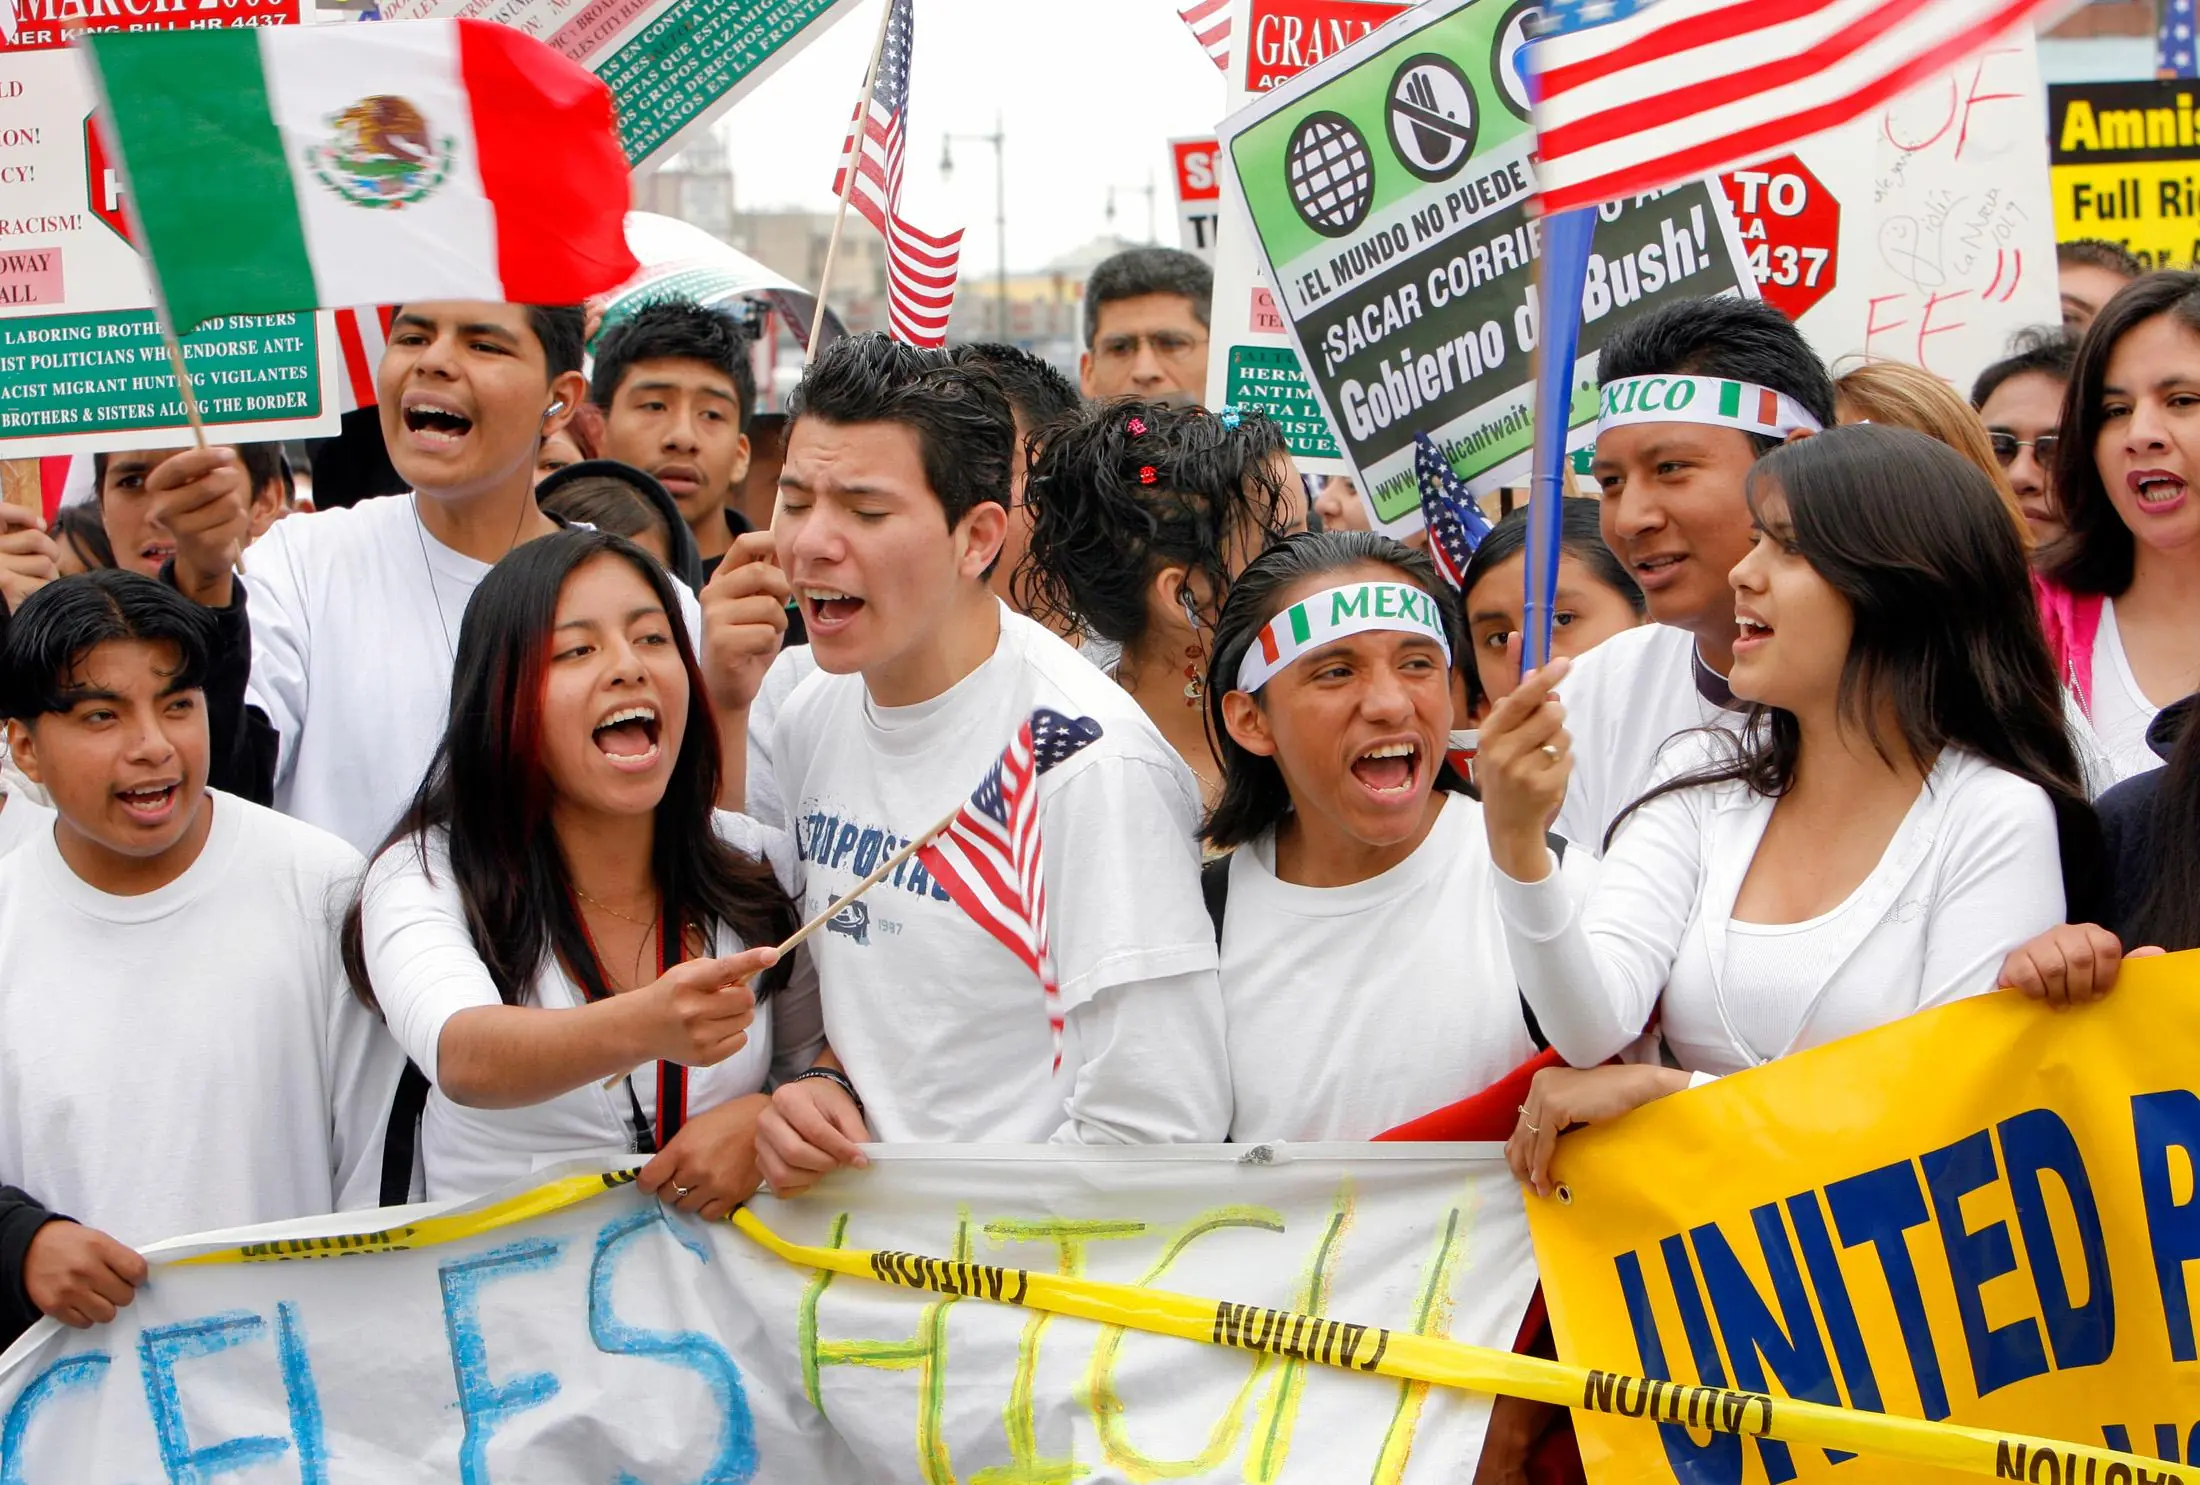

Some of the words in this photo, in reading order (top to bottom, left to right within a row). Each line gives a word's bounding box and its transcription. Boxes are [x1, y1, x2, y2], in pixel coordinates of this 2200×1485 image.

[190, 17, 222, 30] HR
[231, 14, 287, 29] 4437
[593, 14, 621, 42] CITY
[619, 40, 642, 63] EN
[641, 0, 700, 45] CONTR
[658, 42, 692, 74] QUE
[692, 1, 741, 45] ESTAN
[1256, 13, 1353, 67] GRAN
[637, 56, 700, 111] GRUPOS
[699, 0, 777, 60] CAZAMIG
[652, 89, 685, 120] LOS
[684, 23, 766, 93] DERECHOS
[706, 70, 731, 95] EN
[732, 49, 758, 73] LA
[1329, 222, 1410, 286] MUNDO
[1411, 202, 1445, 243] NO
[1446, 160, 1529, 224] PUEDE
[2072, 178, 2139, 222] Full
[2159, 176, 2200, 228] Ri
[5, 323, 92, 345] LABORING
[229, 312, 296, 329] SISTERS
[1321, 283, 1424, 377] ¡SACAR
[1338, 319, 1506, 442] Gobierno
[1580, 204, 1711, 324] Bush!
[31, 349, 135, 370] POLITICIANS
[184, 342, 258, 359] ENDORSE
[263, 337, 304, 354] ANTI-
[1, 383, 47, 399] ACIST
[52, 377, 127, 396] MIGRANT
[210, 366, 308, 384] VIGILANTES
[2, 409, 78, 428] BROTHERS
[83, 407, 93, 421] &
[98, 402, 155, 421] SISTERS
[213, 395, 242, 413] THE
[247, 391, 308, 410] BORDER
[1237, 384, 1314, 400] ANTIM
[1331, 586, 1445, 640] MEXIC
[1614, 1108, 2115, 1485] UNITED
